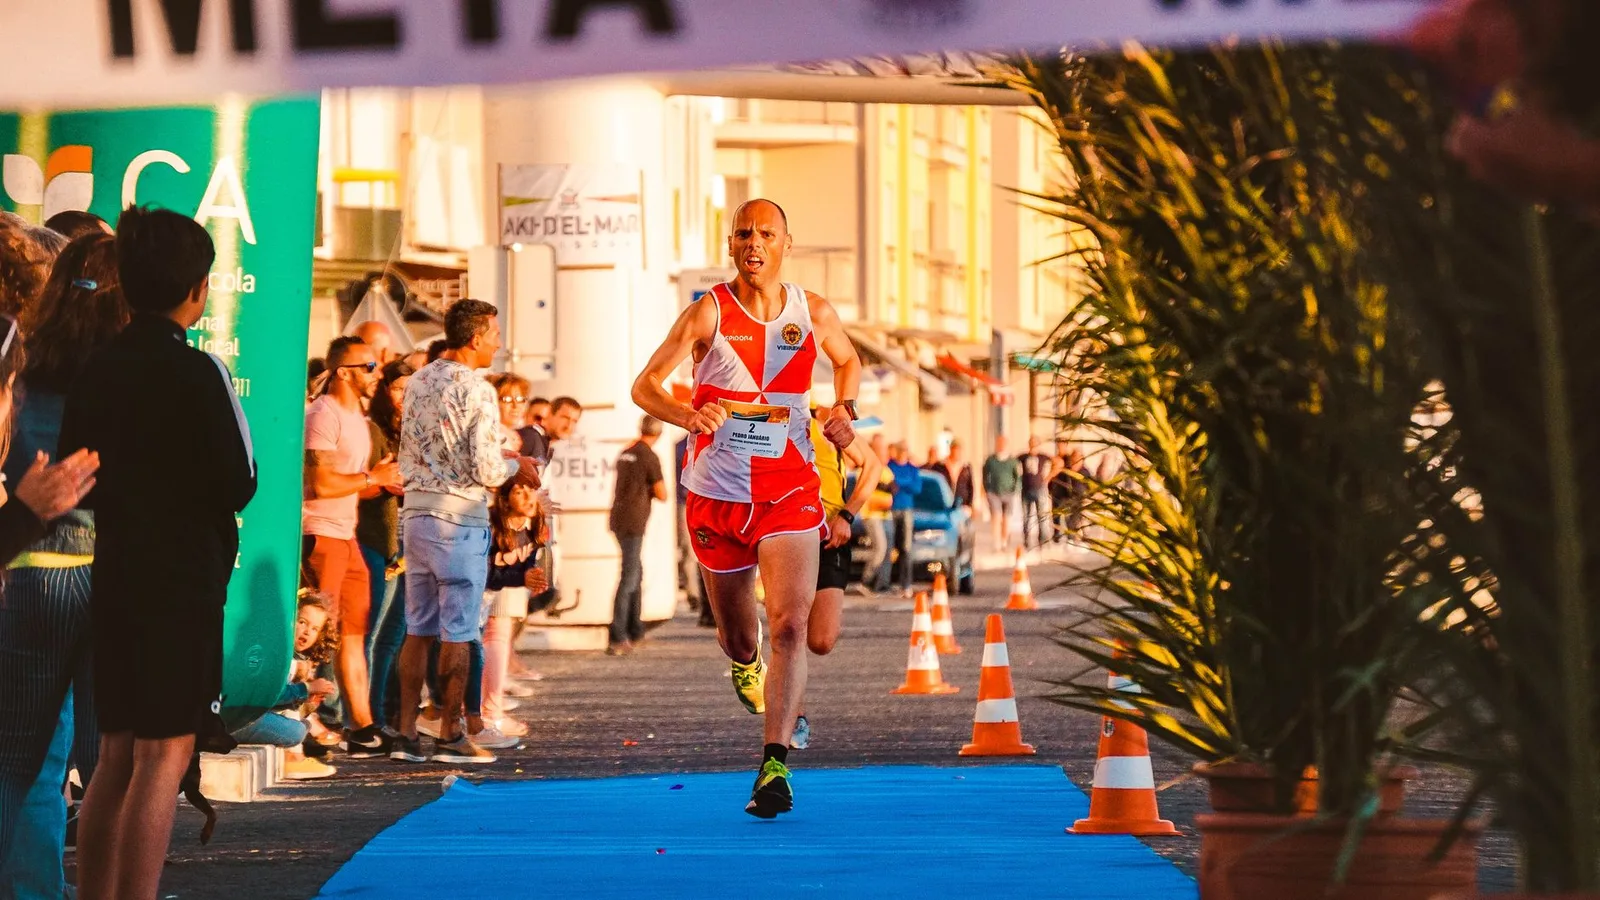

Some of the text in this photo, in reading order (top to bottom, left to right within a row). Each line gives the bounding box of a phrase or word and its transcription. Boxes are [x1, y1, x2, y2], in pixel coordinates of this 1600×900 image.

[121, 149, 257, 245] CA
[208, 267, 256, 293] cola
[232, 377, 250, 397] 911
[748, 423, 756, 433] 2
